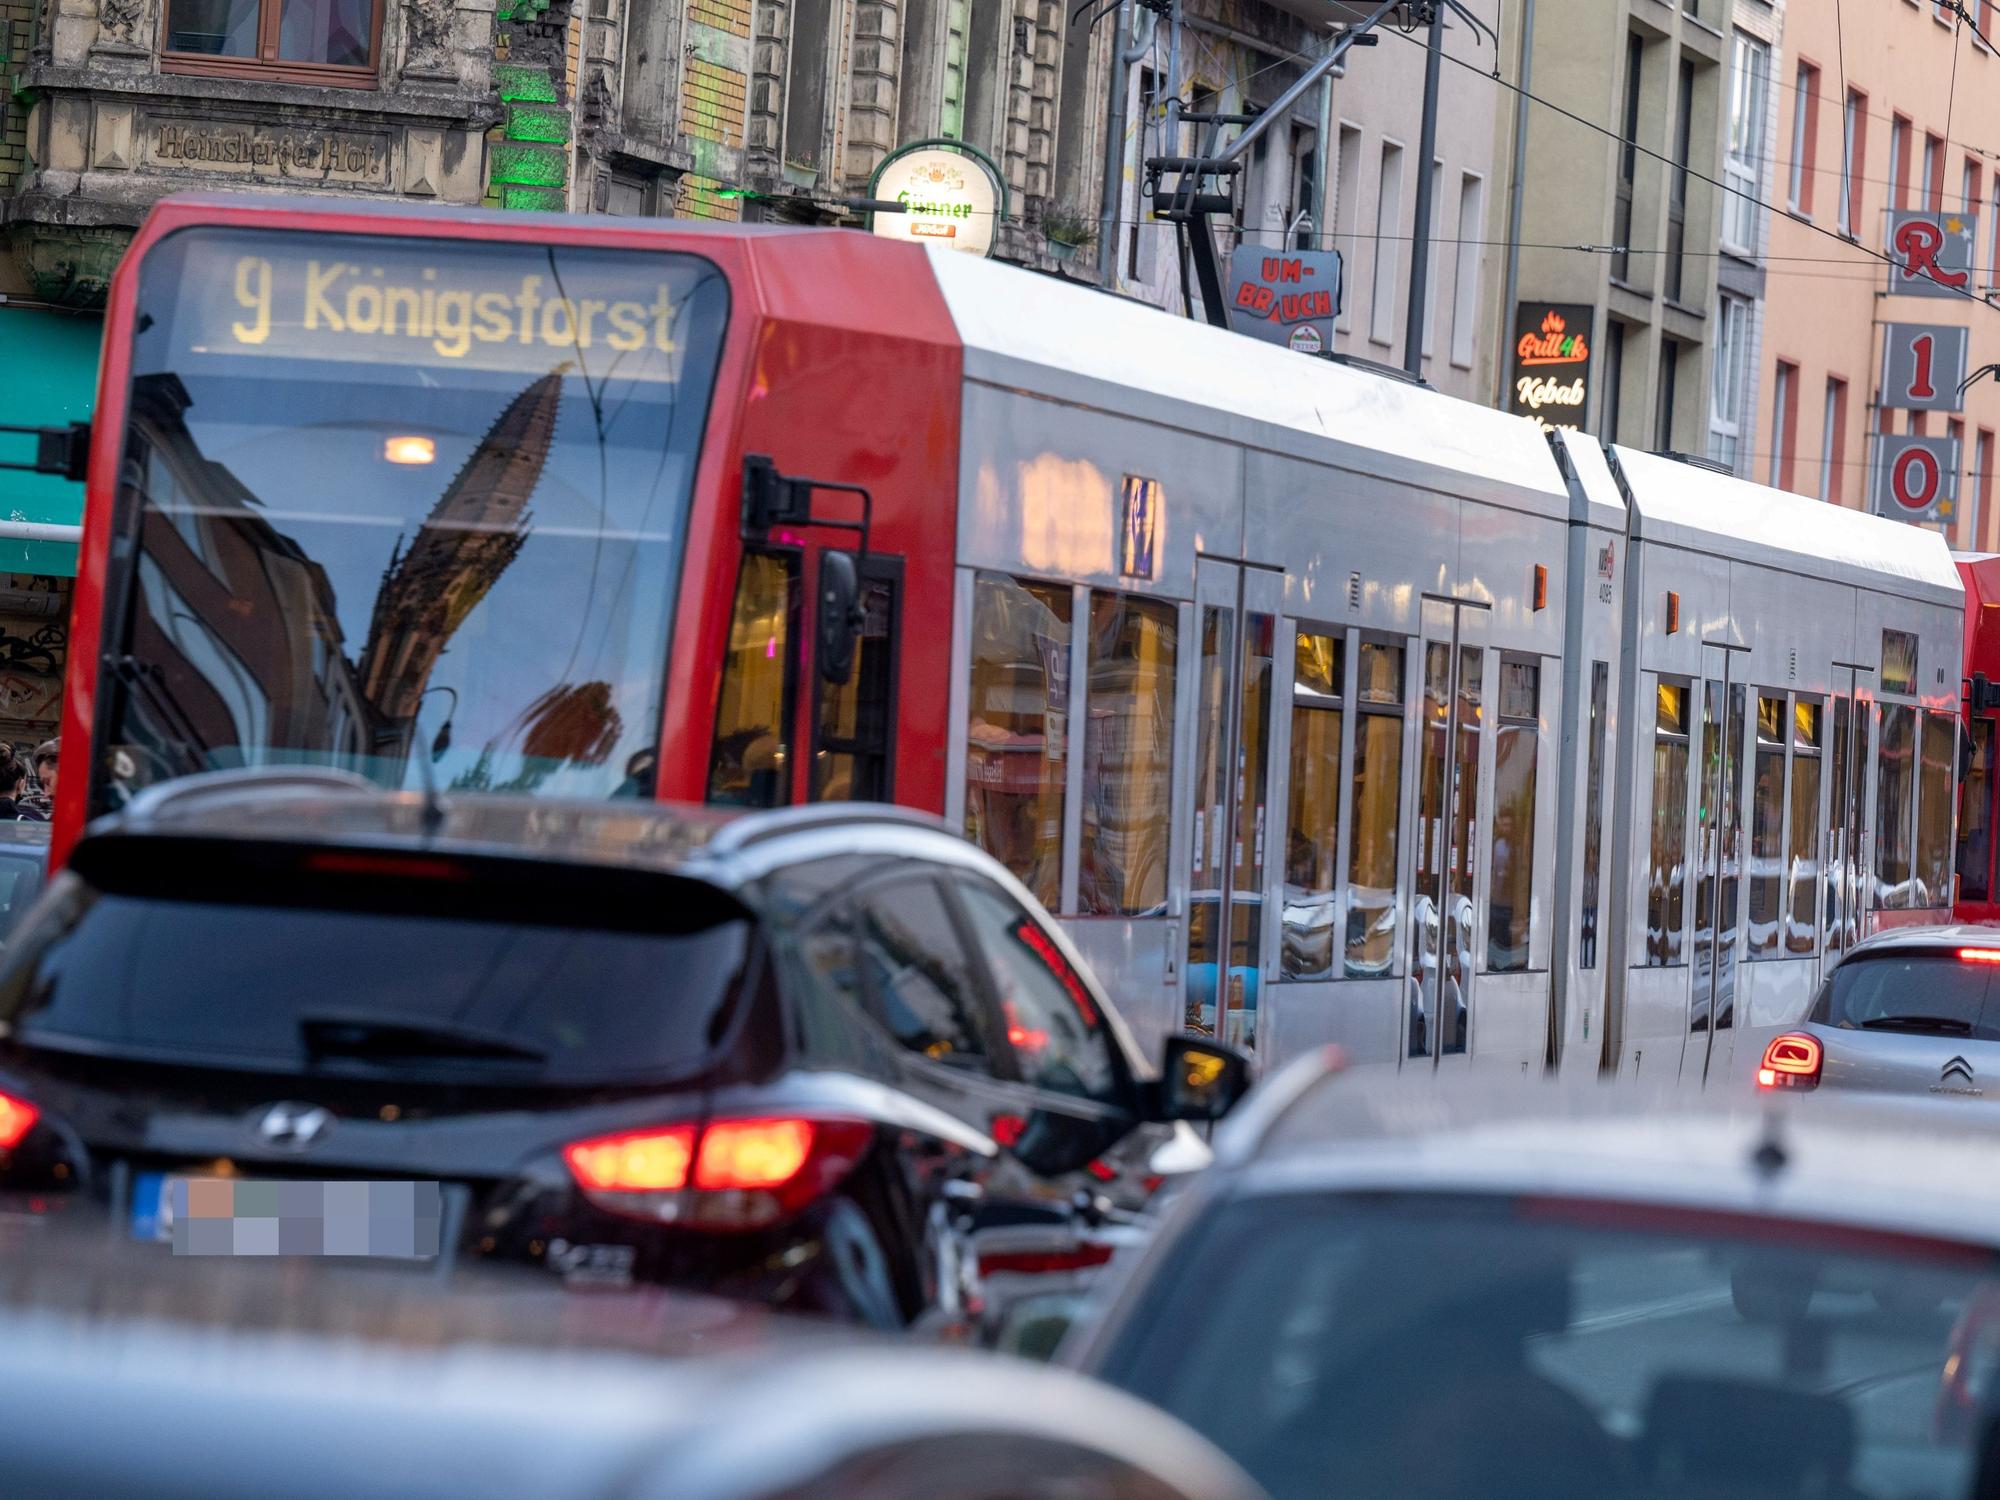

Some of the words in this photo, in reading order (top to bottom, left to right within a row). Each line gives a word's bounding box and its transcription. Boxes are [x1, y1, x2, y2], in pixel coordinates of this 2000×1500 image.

[156, 124, 318, 176] Heinsberger
[1261, 256, 1314, 283] UM-
[1895, 220, 1968, 287] R
[232, 255, 273, 344] 9
[303, 259, 676, 358] Königsforst
[1518, 332, 1588, 361] Grill4k
[1517, 376, 1585, 409] Kebab
